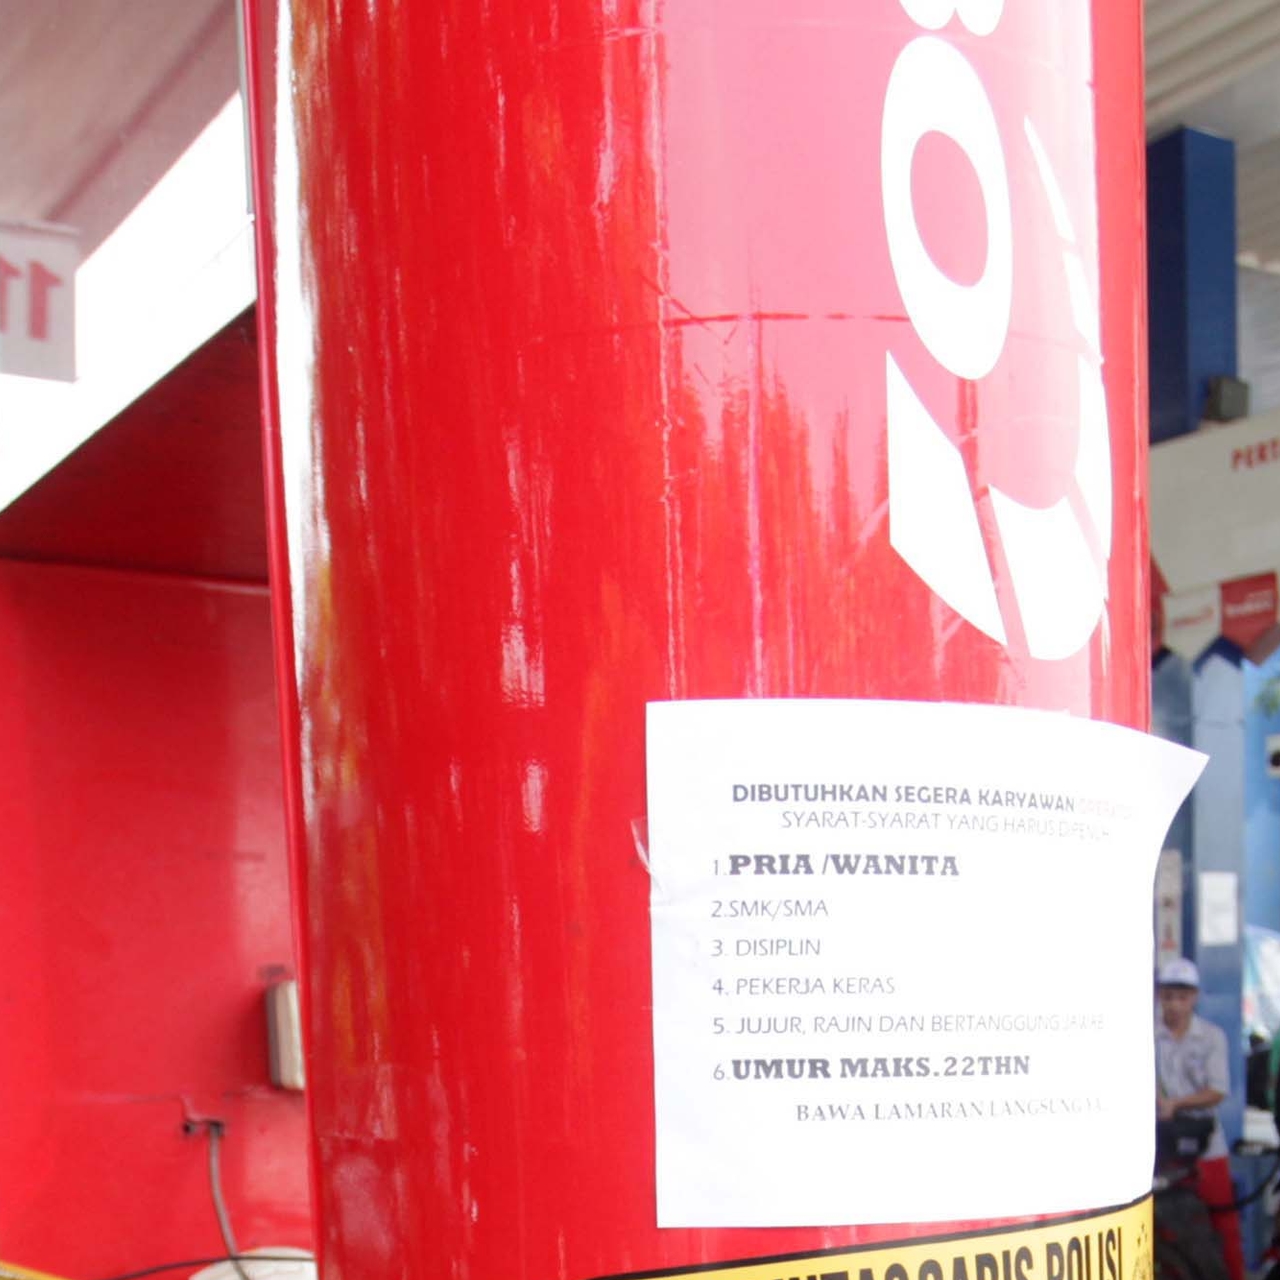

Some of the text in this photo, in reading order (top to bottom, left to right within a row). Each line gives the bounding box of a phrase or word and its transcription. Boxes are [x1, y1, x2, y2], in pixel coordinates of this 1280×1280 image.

[732, 784, 888, 803] DIBUTUHKAN
[895, 786, 972, 806] SEGERA
[978, 788, 1075, 813] KARYAWAN
[781, 810, 942, 830] SYARAT-SYARAT
[947, 813, 999, 832] YANG
[1003, 816, 1055, 837] HARUS
[736, 938, 822, 956] DISIPLIN
[736, 977, 826, 996] PEKERJA
[832, 976, 897, 995] KERAS
[735, 1016, 807, 1035] JUJUR,
[814, 1015, 873, 1033] RAJIN
[878, 1014, 926, 1033] DAN
[931, 1013, 1059, 1032] BERTANGGUNG
[795, 1103, 866, 1121] BAWA
[874, 1101, 984, 1120] LAMARAN
